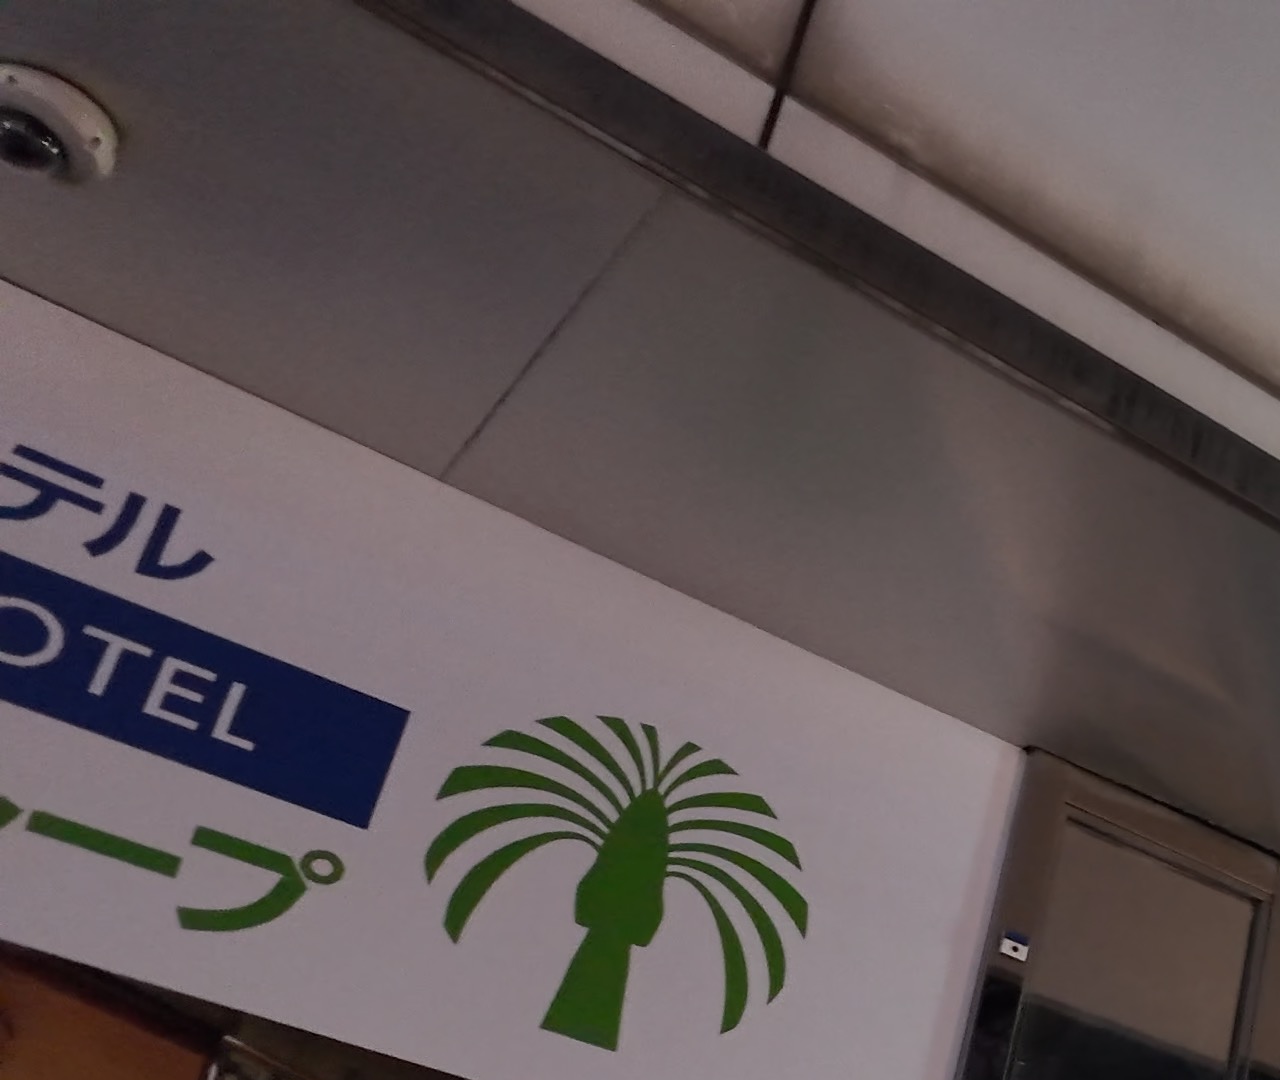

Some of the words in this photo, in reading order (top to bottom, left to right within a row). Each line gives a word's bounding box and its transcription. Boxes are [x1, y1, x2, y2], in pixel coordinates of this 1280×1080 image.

[0, 443, 214, 580] テル
[0, 596, 256, 752] OTEL
[0, 796, 344, 932] ープ
